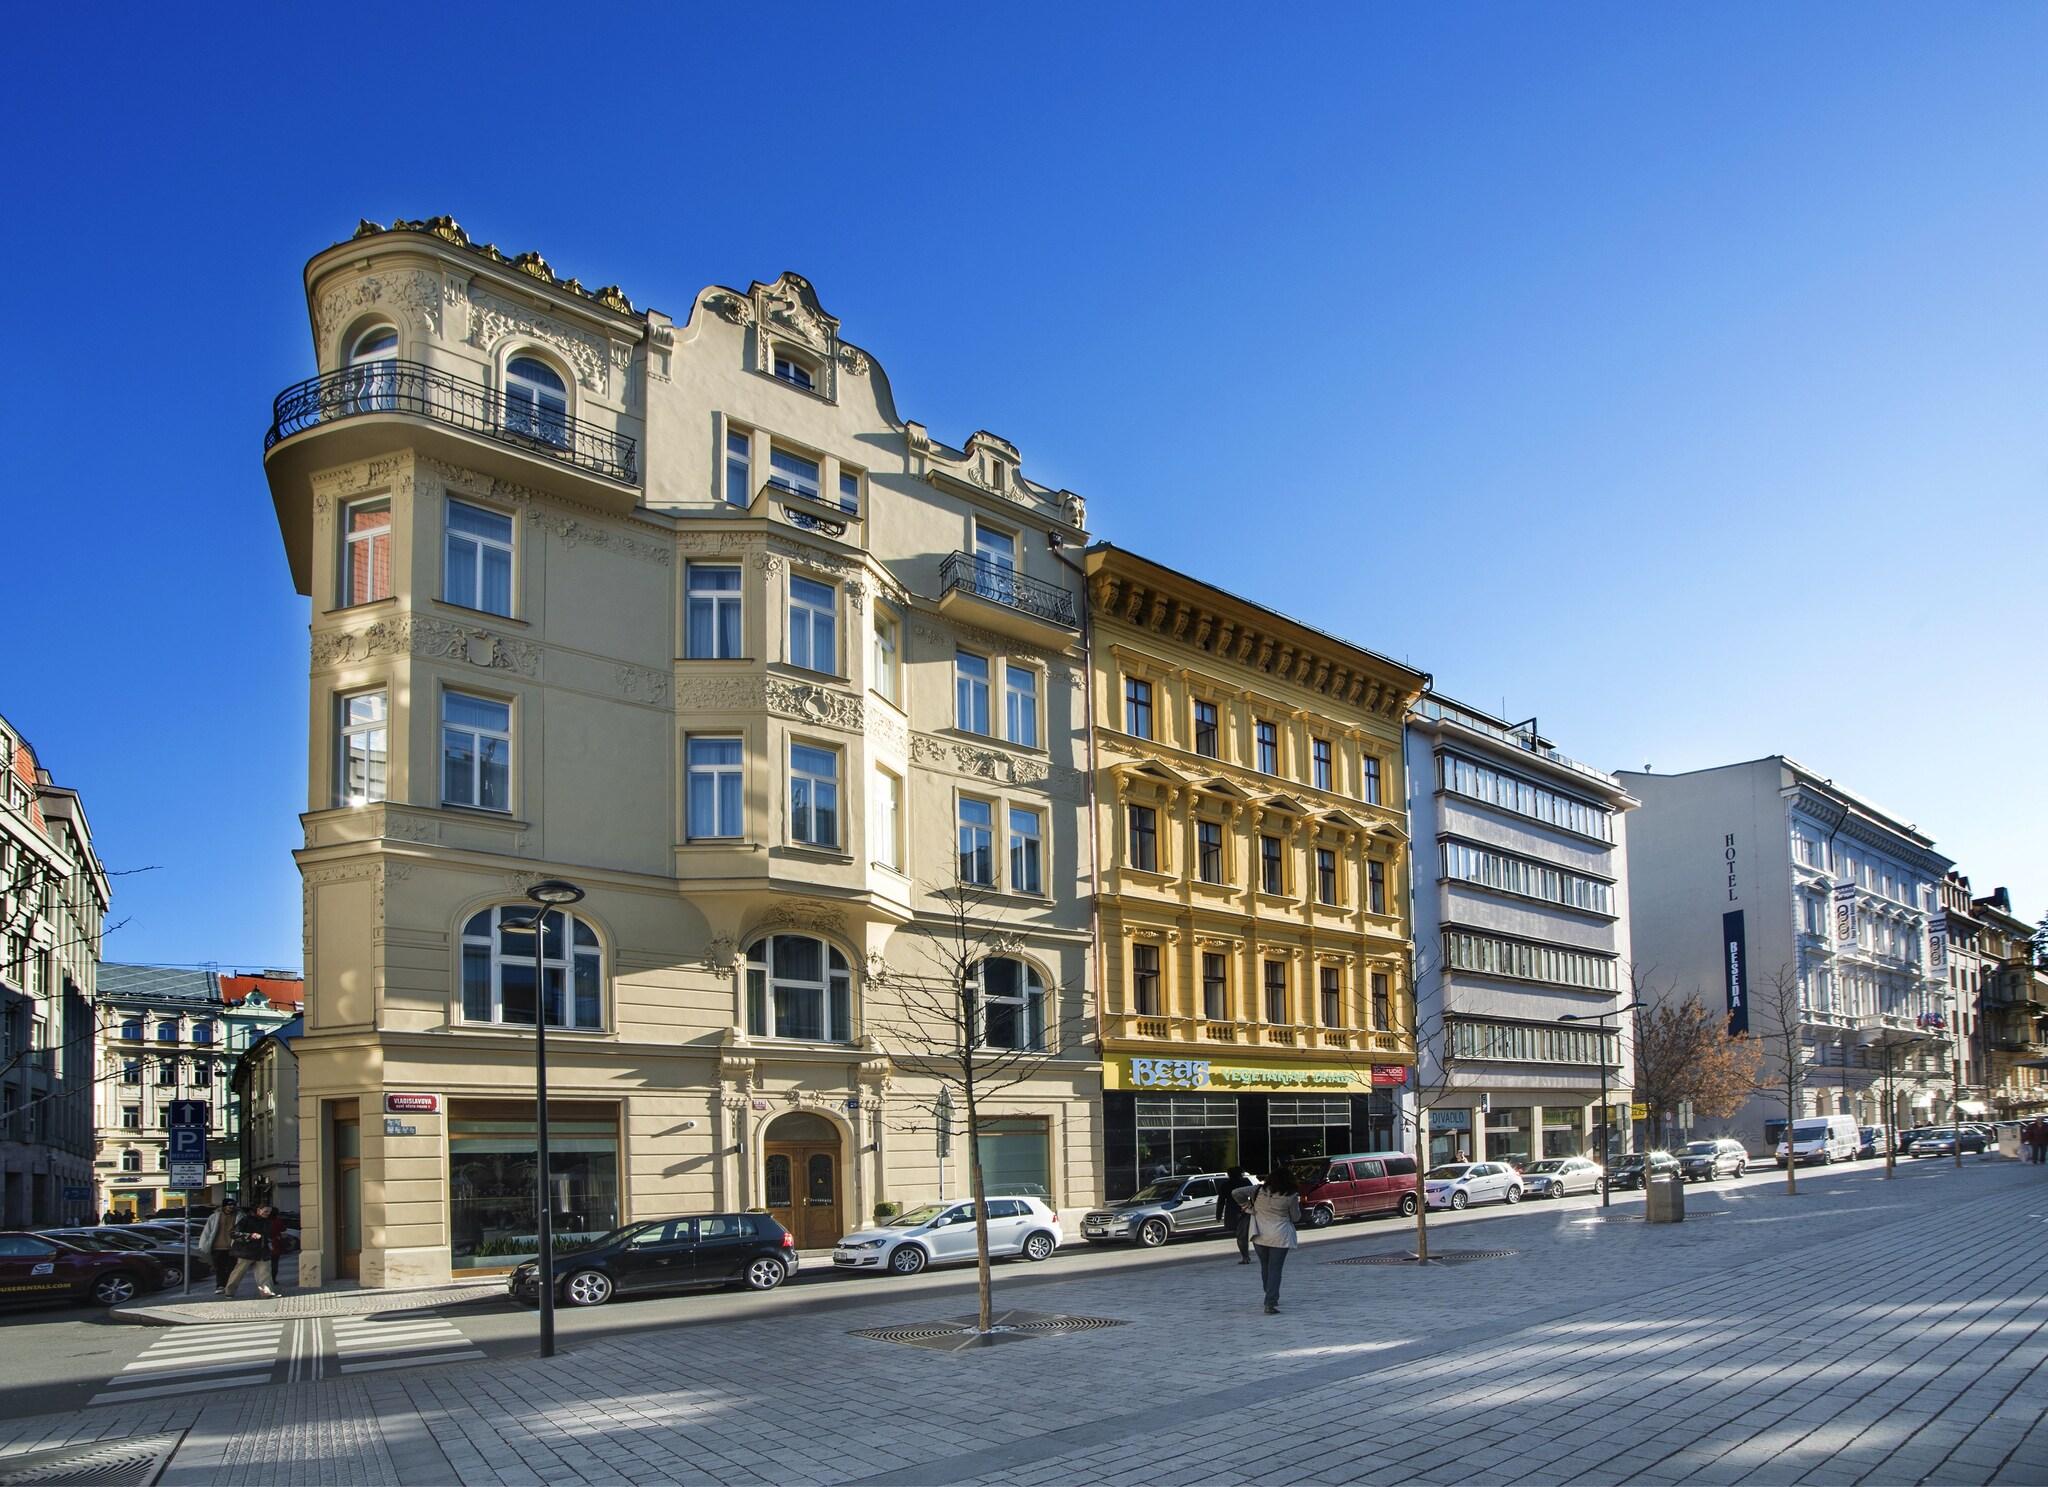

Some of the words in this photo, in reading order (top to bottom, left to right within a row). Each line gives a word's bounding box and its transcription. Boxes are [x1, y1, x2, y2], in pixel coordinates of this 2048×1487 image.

[1725, 833, 1738, 901] HOTEL
[1729, 941, 1741, 1008] BESEDA
[1432, 1112, 1465, 1124] DIVADLO
[177, 1131, 198, 1151] P
